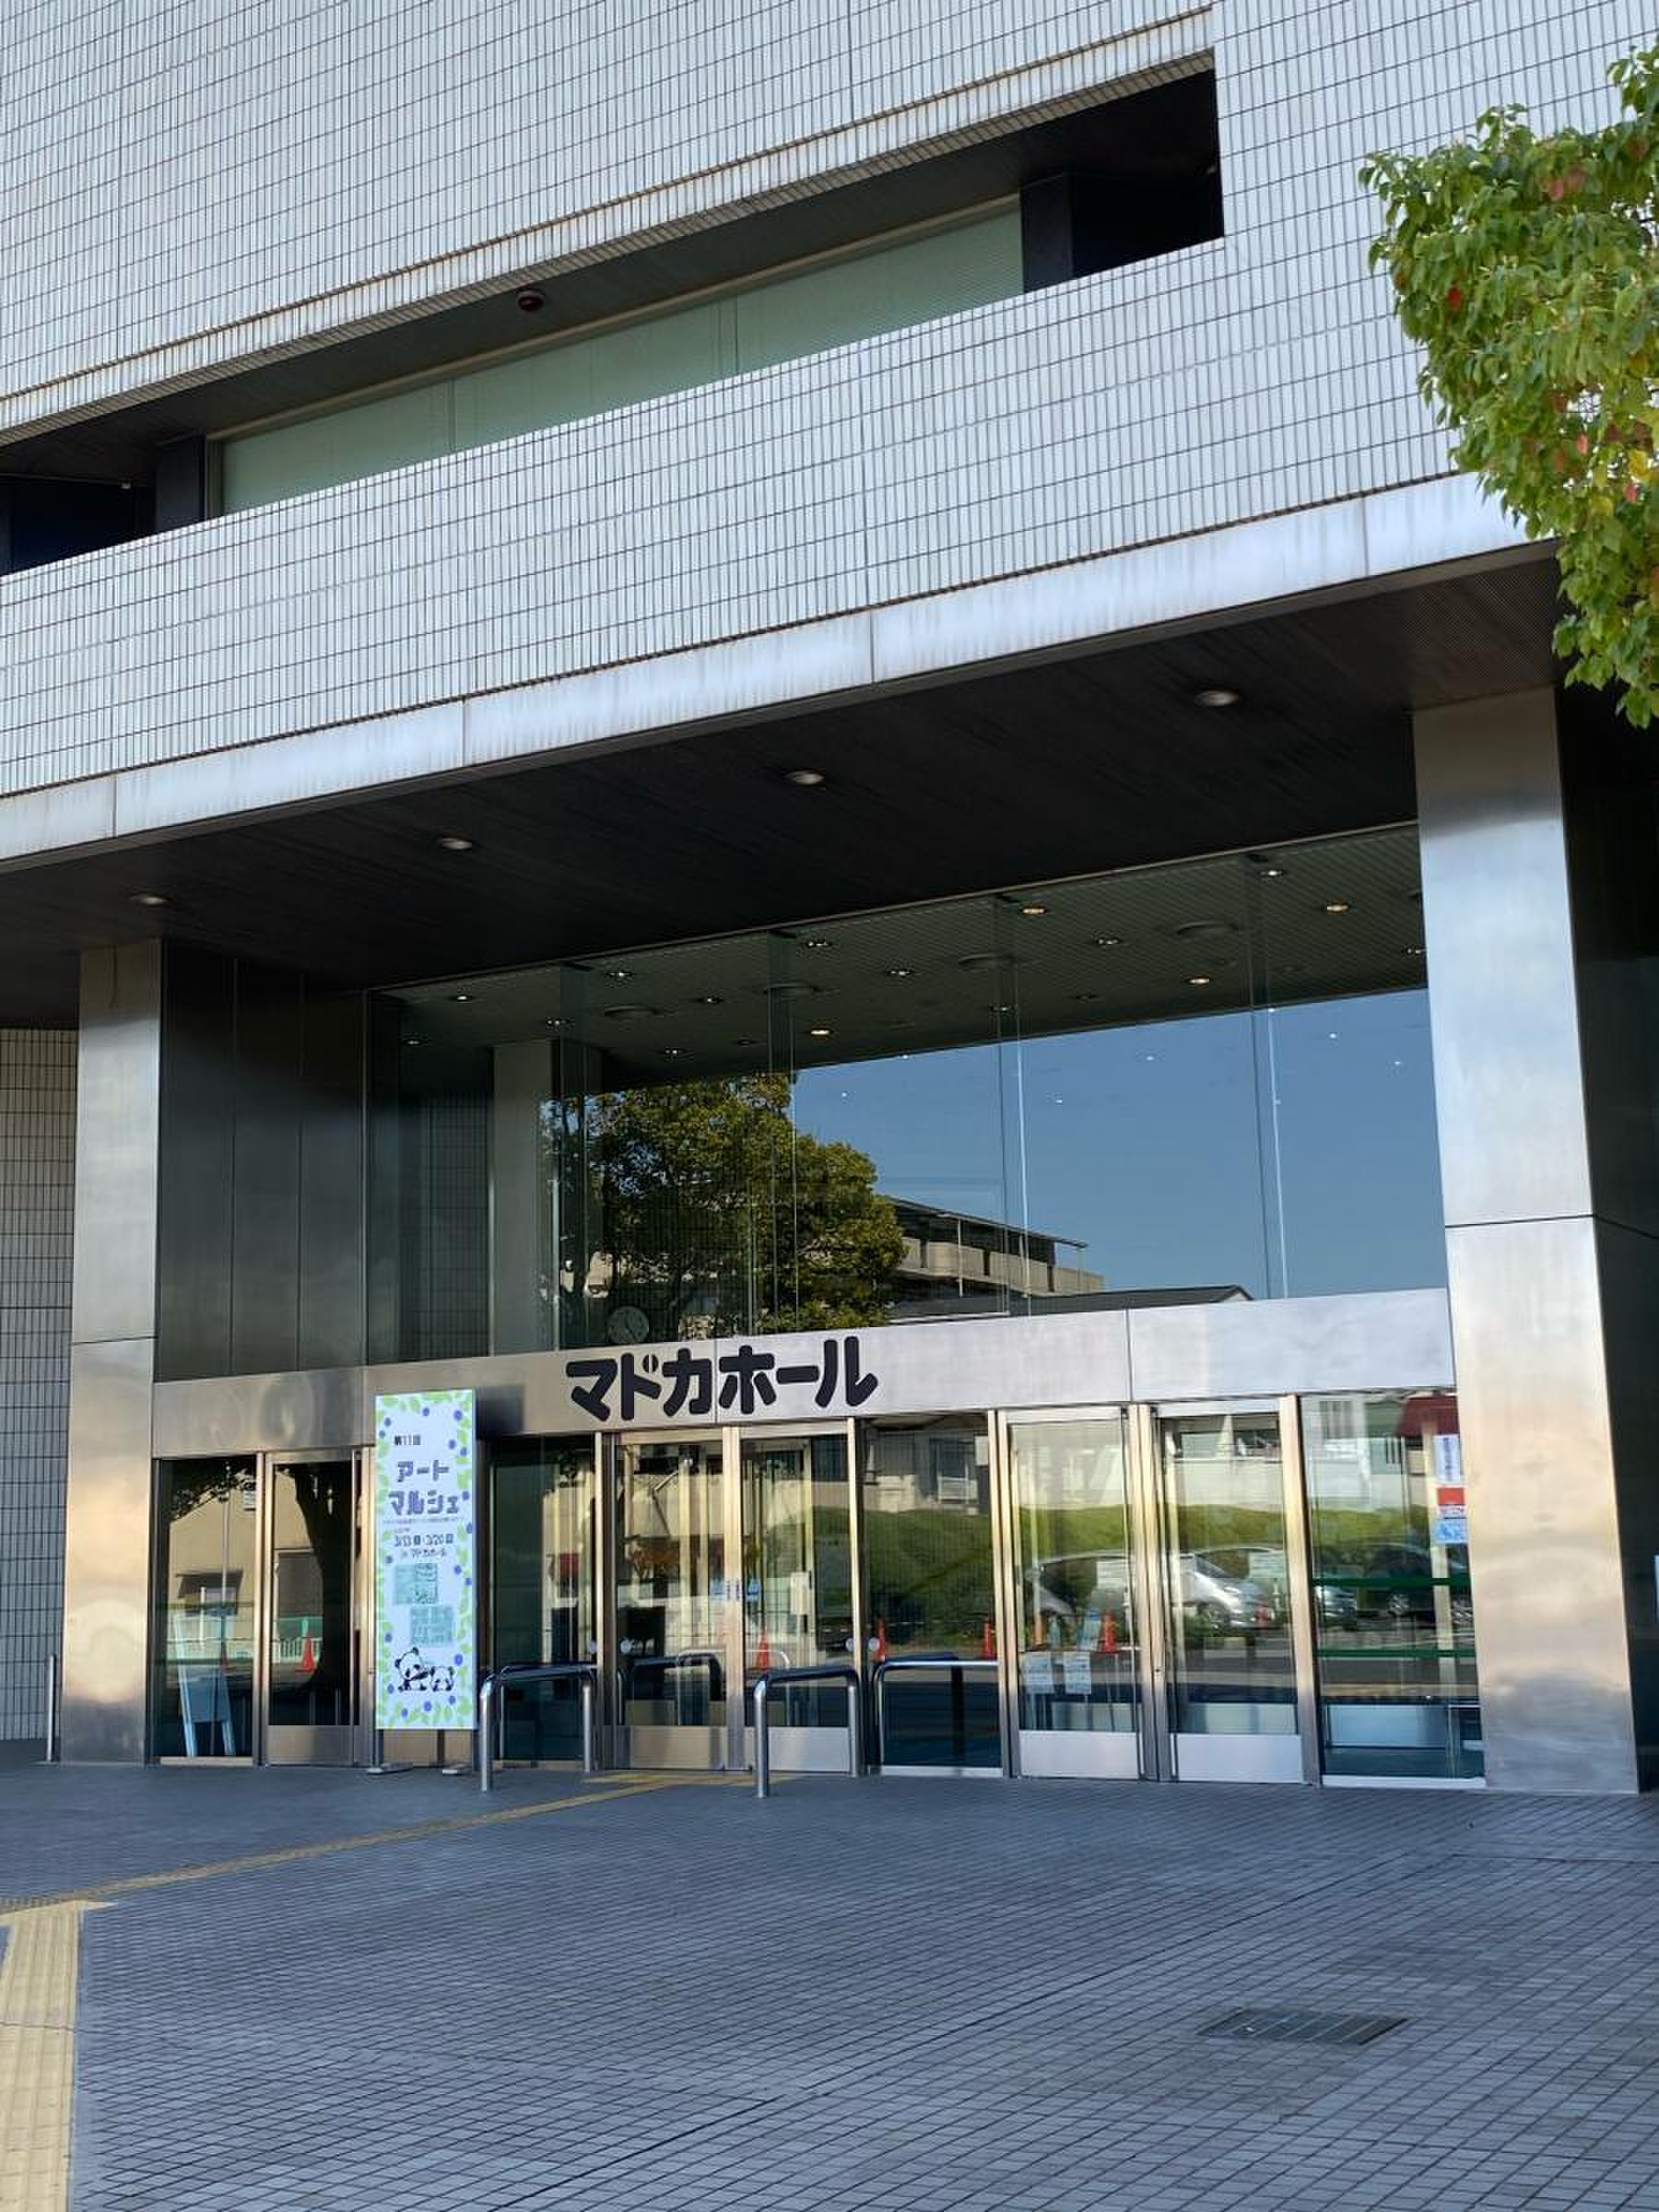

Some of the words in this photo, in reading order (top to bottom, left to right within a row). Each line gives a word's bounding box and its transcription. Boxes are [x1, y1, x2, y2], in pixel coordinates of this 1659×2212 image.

[566, 1335, 878, 1421] マドカホール
[397, 1460, 449, 1482] アート
[389, 1490, 458, 1515] マルシェ
